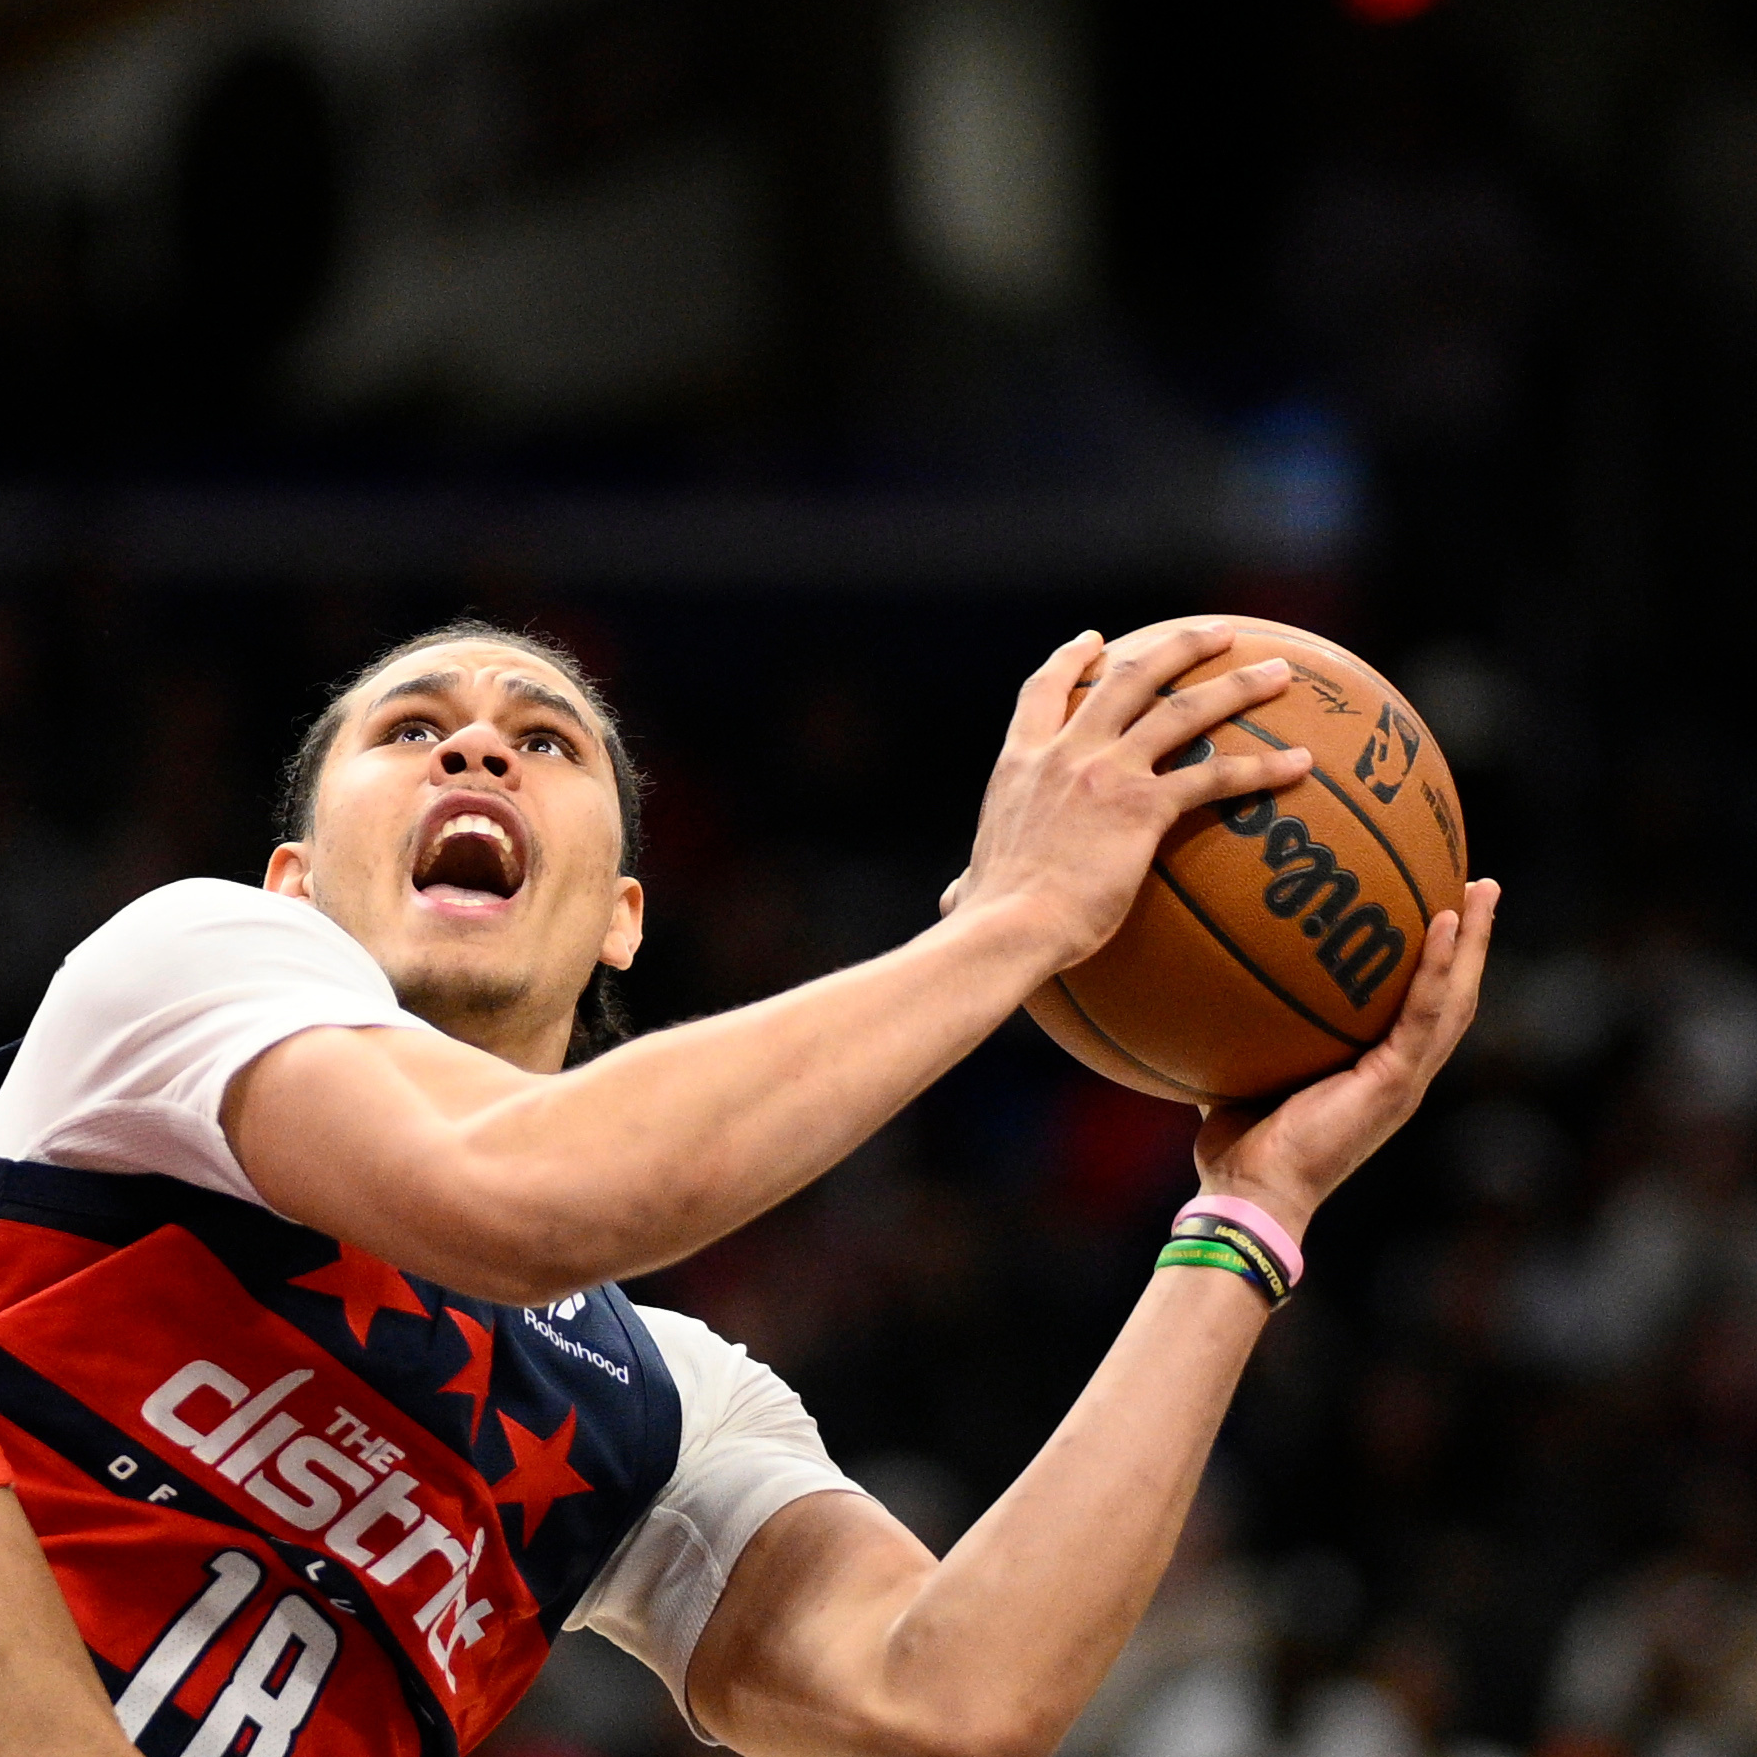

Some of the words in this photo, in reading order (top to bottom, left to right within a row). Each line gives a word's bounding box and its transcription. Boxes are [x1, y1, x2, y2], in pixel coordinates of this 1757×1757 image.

[1172, 733, 1408, 1011] Wilso
[1214, 1224, 1287, 1298] WASHINGTON
[523, 1306, 630, 1386] Robinhood
[324, 1405, 407, 1475] THE
[107, 1454, 179, 1504] OF
